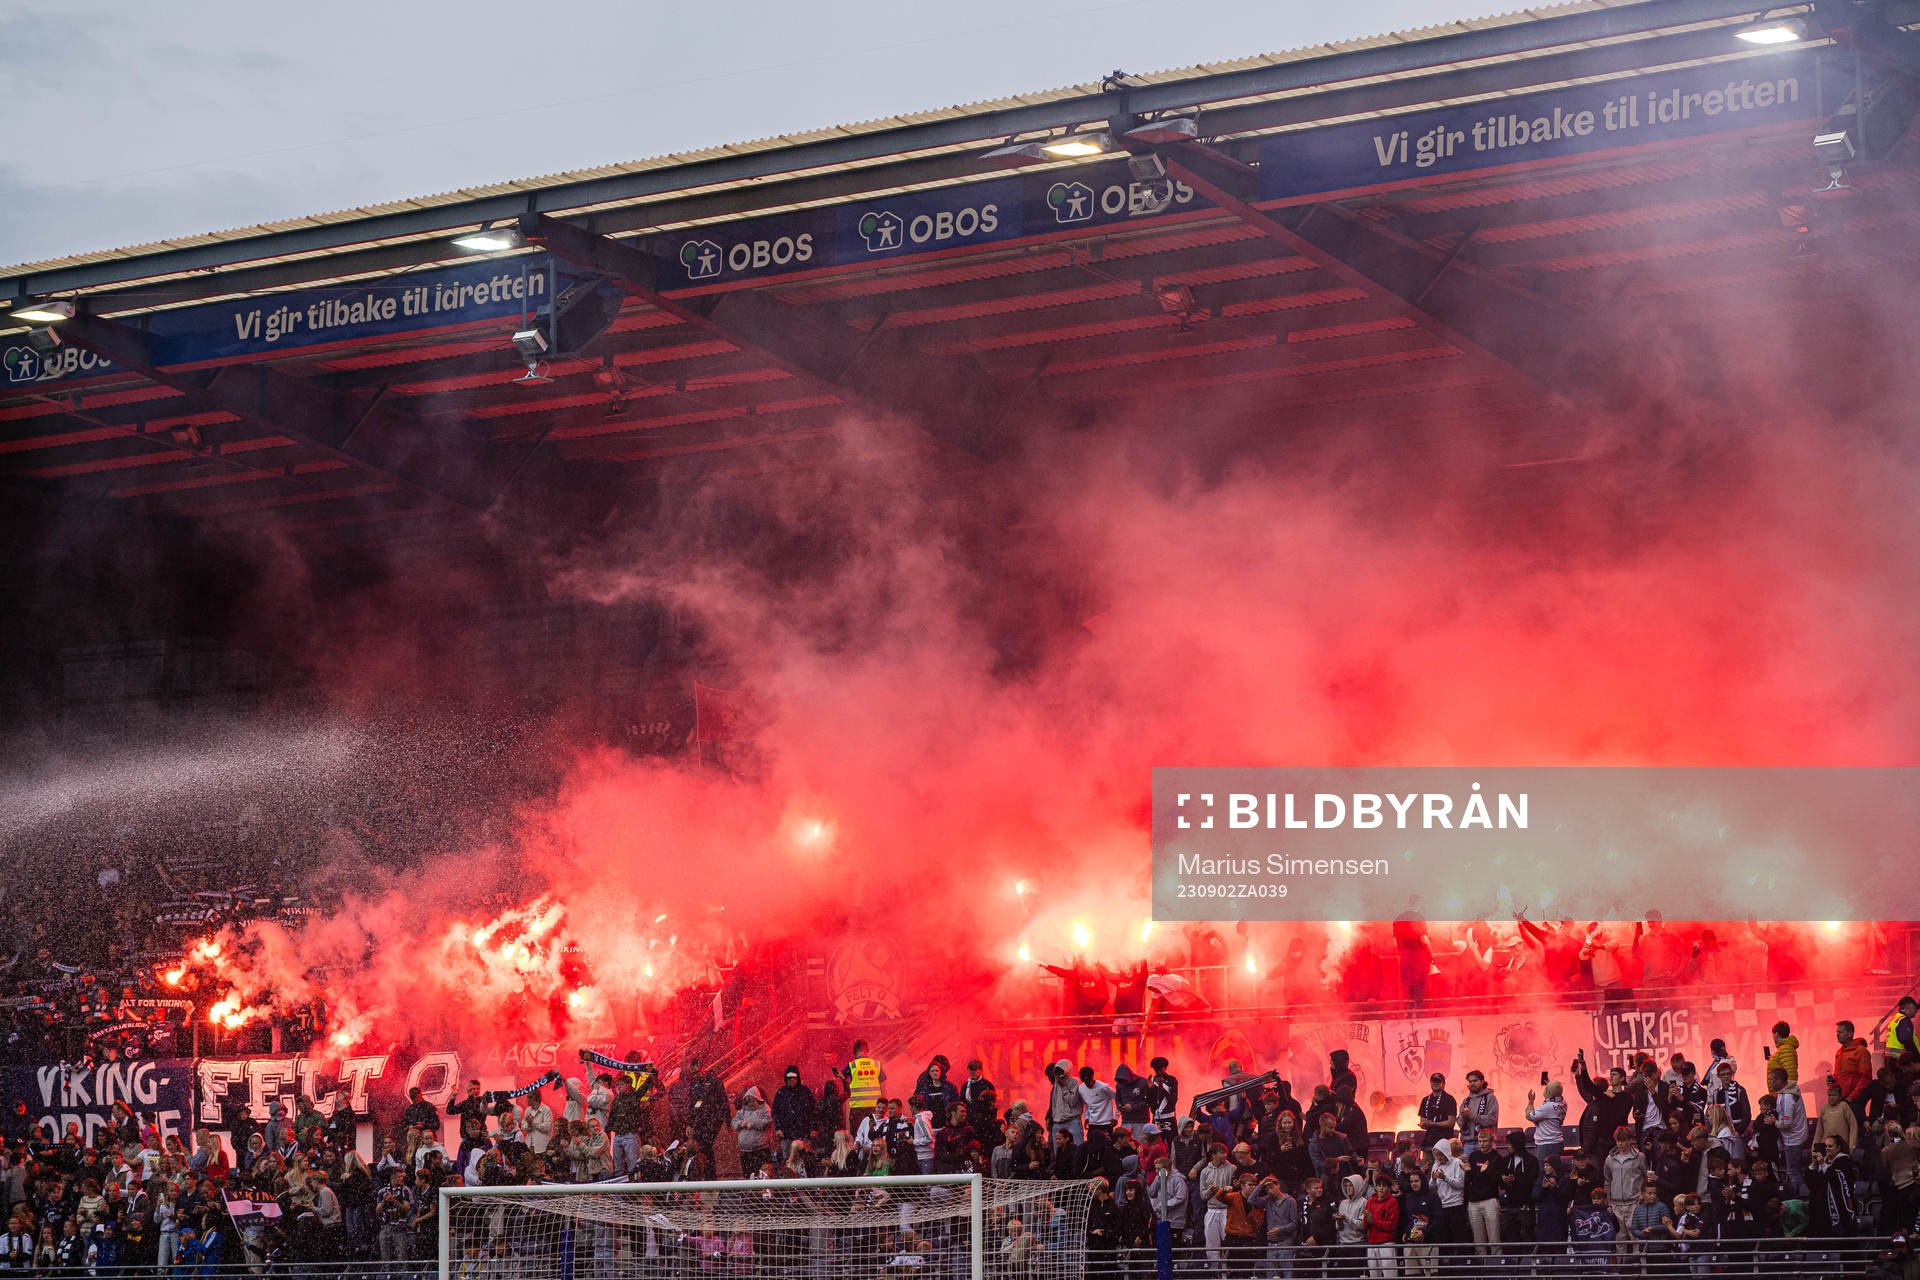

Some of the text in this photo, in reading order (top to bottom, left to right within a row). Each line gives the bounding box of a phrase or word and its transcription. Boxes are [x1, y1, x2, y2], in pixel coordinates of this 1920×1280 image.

[1373, 75, 1799, 168] Vi gir tilbake til idretten
[909, 204, 998, 243] OBOS
[728, 233, 813, 271] OBOS
[234, 272, 544, 342] Vi gir tilbake til idretten
[43, 347, 112, 375] OBO
[121, 999, 186, 1009] ALT FOR VIKING
[844, 985, 873, 1003] FELT
[1593, 1008, 1690, 1049] ULTRAS
[593, 1053, 624, 1071] VIKING
[197, 1055, 389, 1124] FELT
[509, 1075, 548, 1098] VIKING
